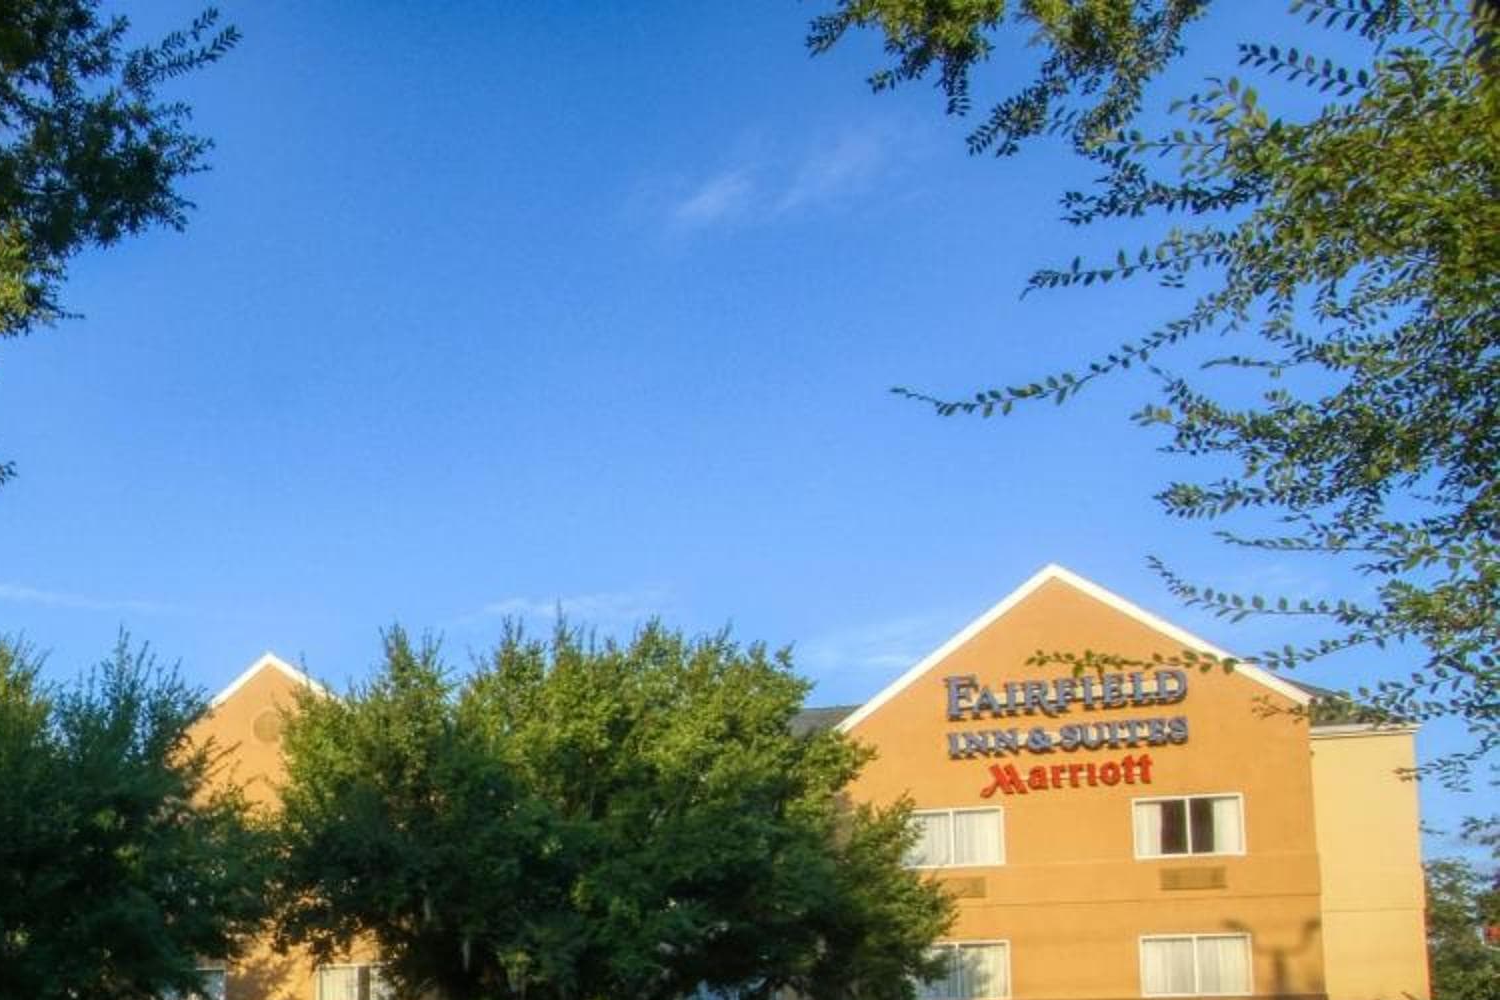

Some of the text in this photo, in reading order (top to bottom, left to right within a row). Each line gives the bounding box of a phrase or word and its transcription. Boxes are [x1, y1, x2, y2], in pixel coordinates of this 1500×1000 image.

[944, 669, 1188, 721] FAIRFIELD
[946, 716, 1189, 760] INN & SUITES
[980, 754, 1153, 798] Marriott
